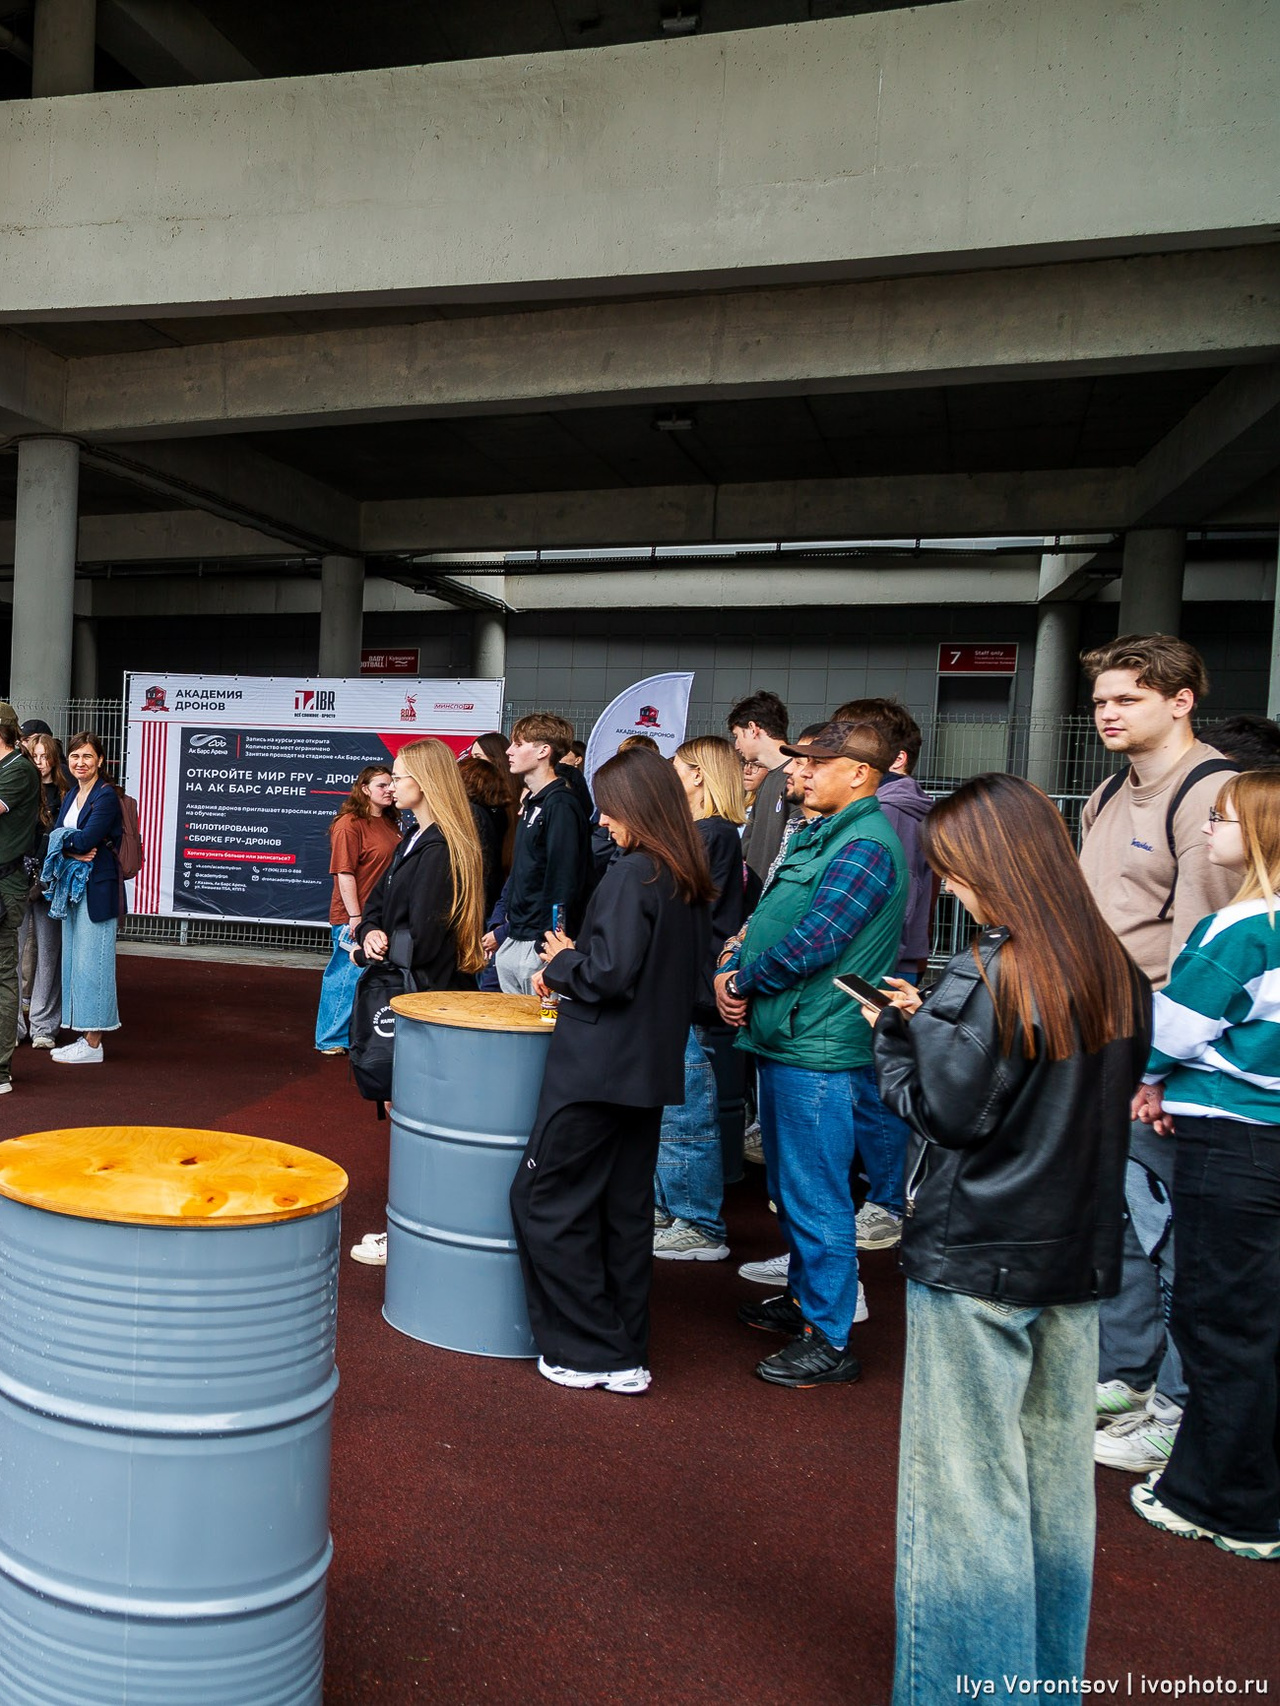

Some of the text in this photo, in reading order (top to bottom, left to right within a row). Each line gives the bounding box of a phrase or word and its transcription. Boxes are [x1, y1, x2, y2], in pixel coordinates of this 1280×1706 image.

[950, 651, 961, 665] 7
[175, 689, 243, 699] АКАДЕМИЯ
[174, 701, 225, 711] ДРОНОВ
[315, 690, 335, 711] IBR
[615, 728, 675, 739] АКАДЕМИЯ ДРОНОВ
[186, 768, 253, 780] ОТКРОЙТЕ
[257, 771, 286, 781] МИР
[290, 773, 314, 782] FPV
[185, 782, 306, 796] НА АК БАРС АРЕНЕ
[189, 823, 268, 833] ПИЛОТИРОВАНИЮ
[189, 834, 282, 846] СБОРКЕ FPV-ДРОНОВ
